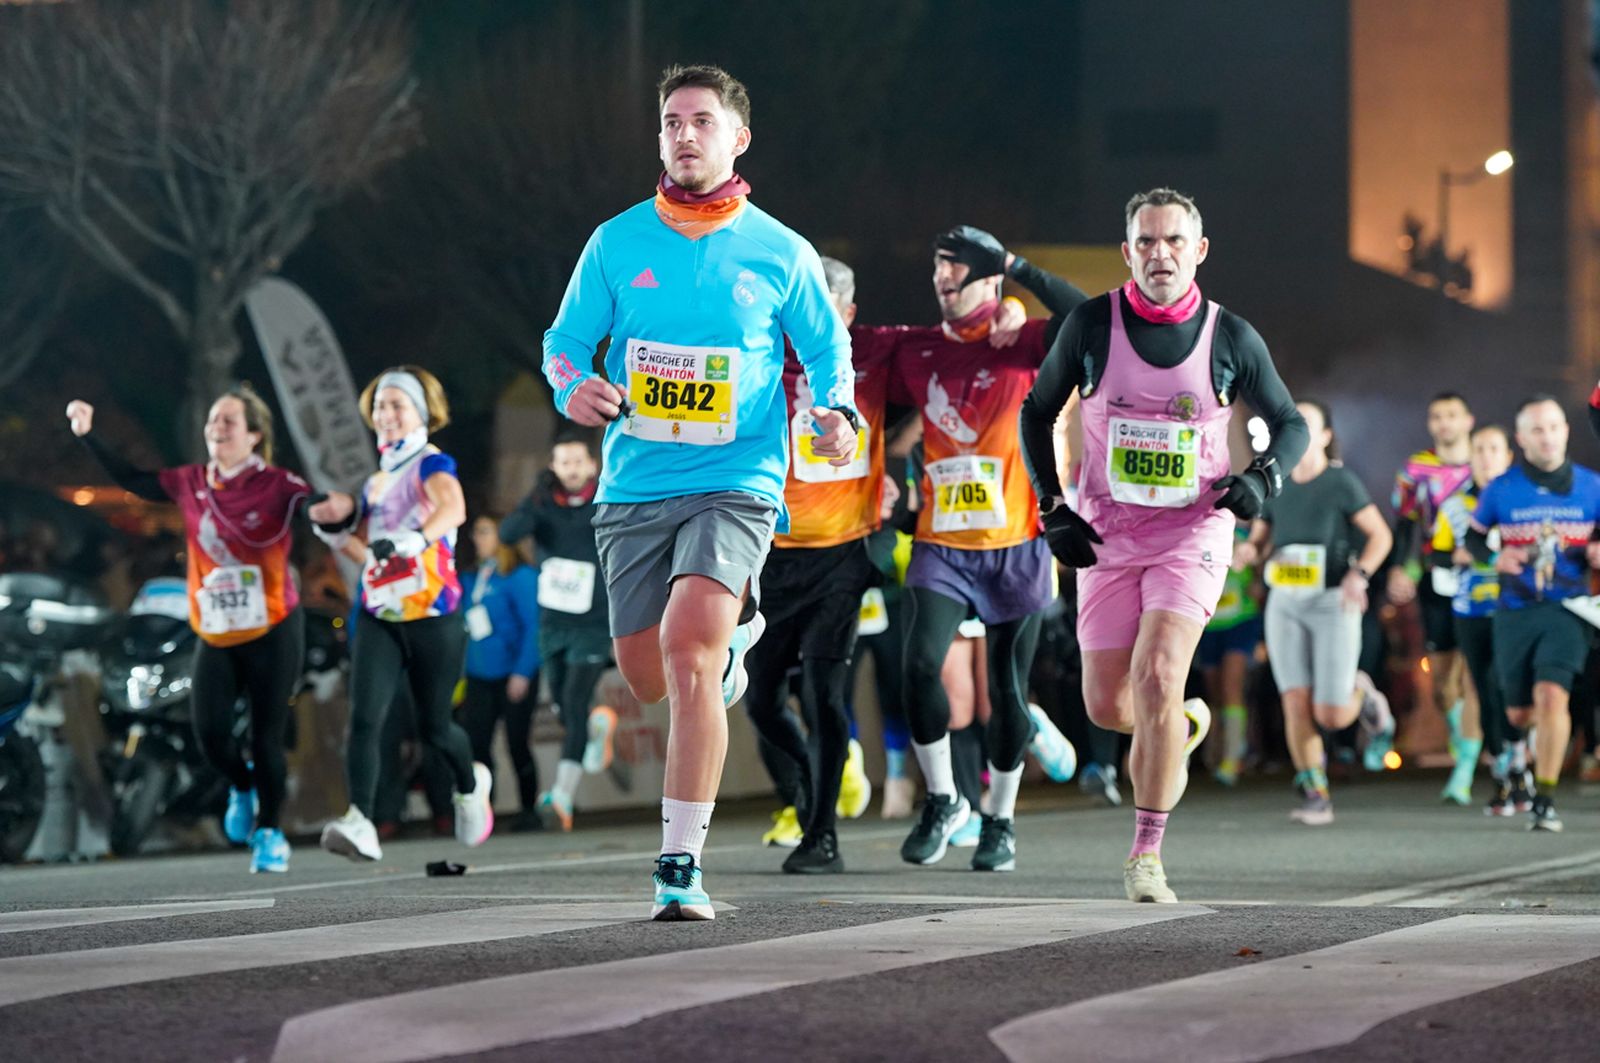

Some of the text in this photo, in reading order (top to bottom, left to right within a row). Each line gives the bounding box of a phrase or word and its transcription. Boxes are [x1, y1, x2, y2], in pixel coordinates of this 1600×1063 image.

[649, 354, 680, 367] NOCHE
[682, 357, 696, 368] DE
[638, 363, 658, 375] SAN
[659, 367, 695, 380] ANTÓN
[644, 376, 715, 411] 3642
[1129, 430, 1169, 440] NOCHE DE
[1119, 439, 1136, 448] SAN
[1124, 450, 1185, 478] 8598
